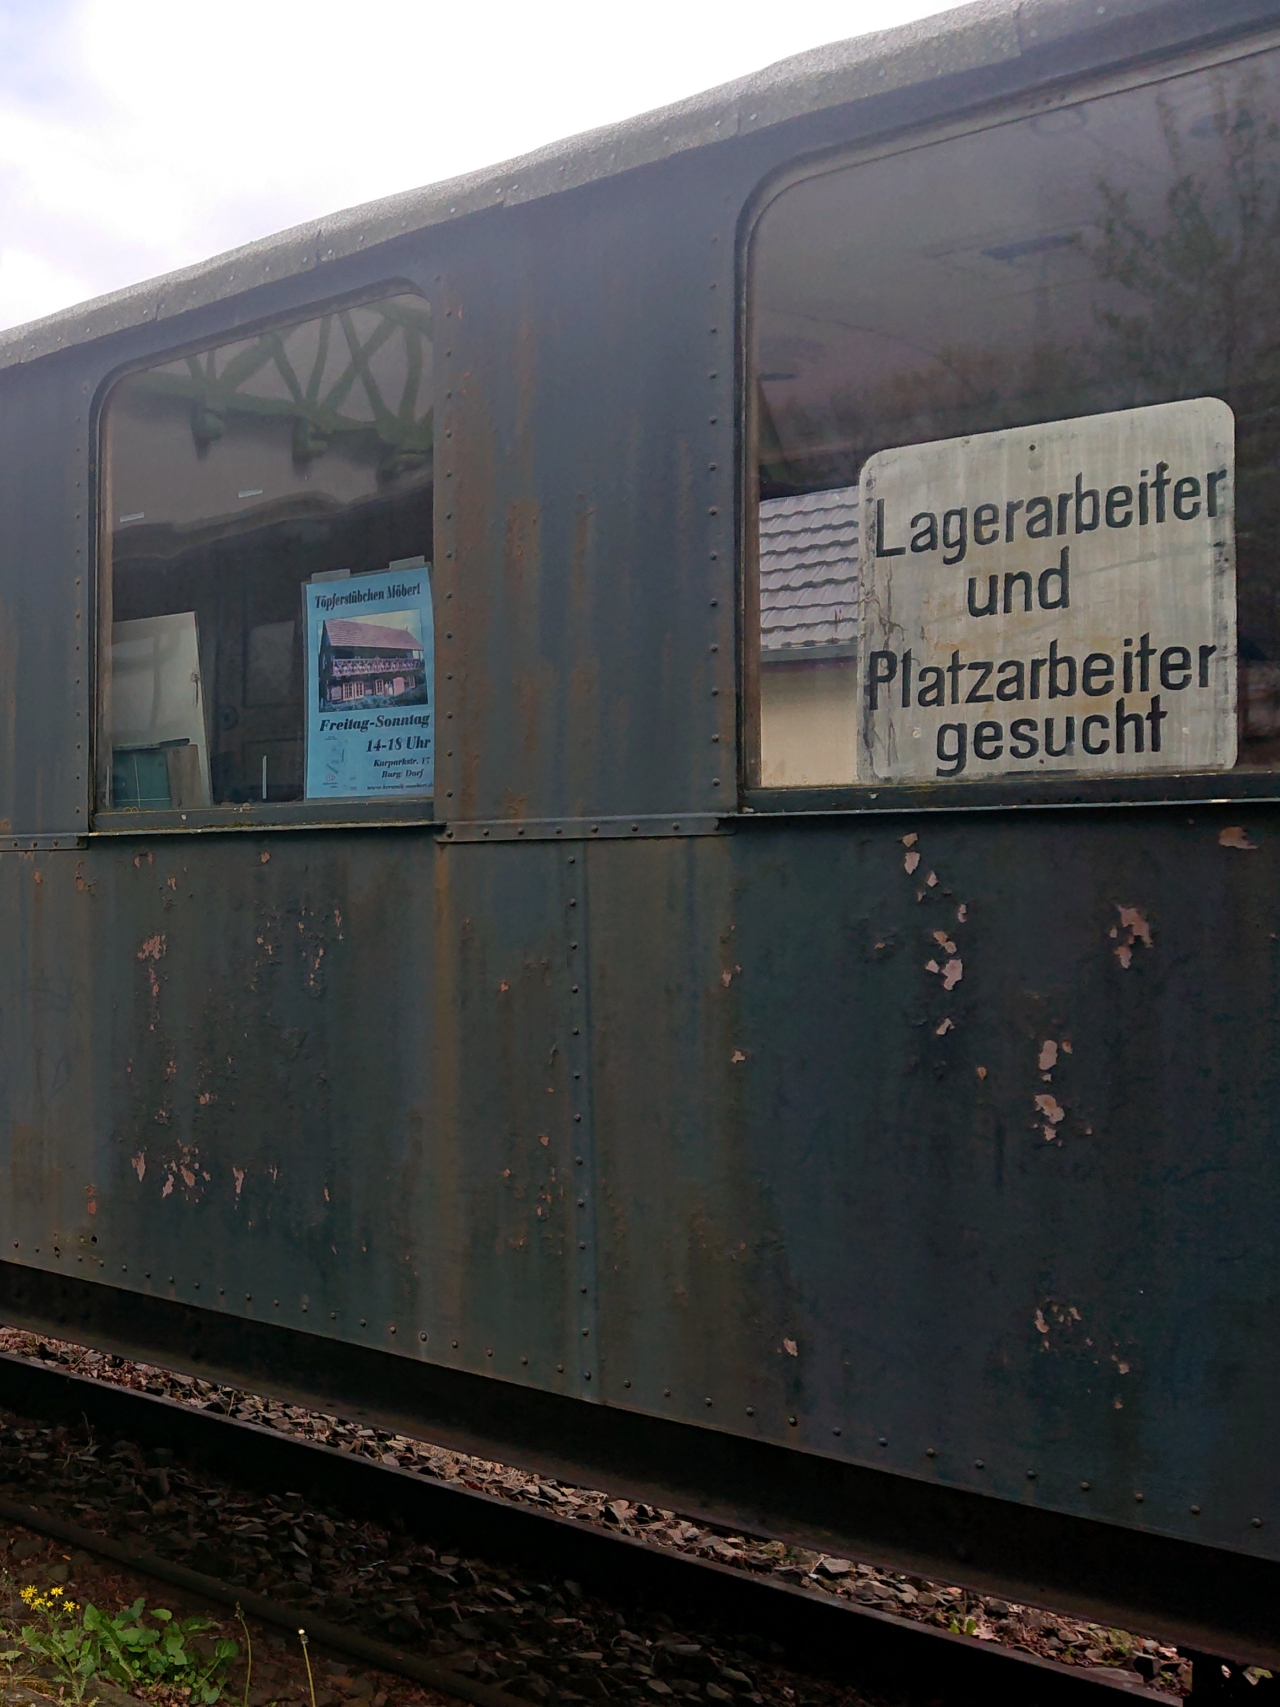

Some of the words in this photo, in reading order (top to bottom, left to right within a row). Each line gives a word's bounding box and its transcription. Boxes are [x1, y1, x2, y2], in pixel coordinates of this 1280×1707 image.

[875, 461, 1227, 565] Lagerarbeiter
[315, 589, 385, 611] Töpferstübchen
[387, 583, 421, 599] Möbert
[967, 545, 1070, 617] und
[870, 632, 1217, 711] Platzarbeiter
[320, 714, 430, 732] Freitag-Sonntag
[366, 738, 403, 752] 14-18
[406, 736, 431, 750] Uhr
[936, 694, 1168, 777] gesucht
